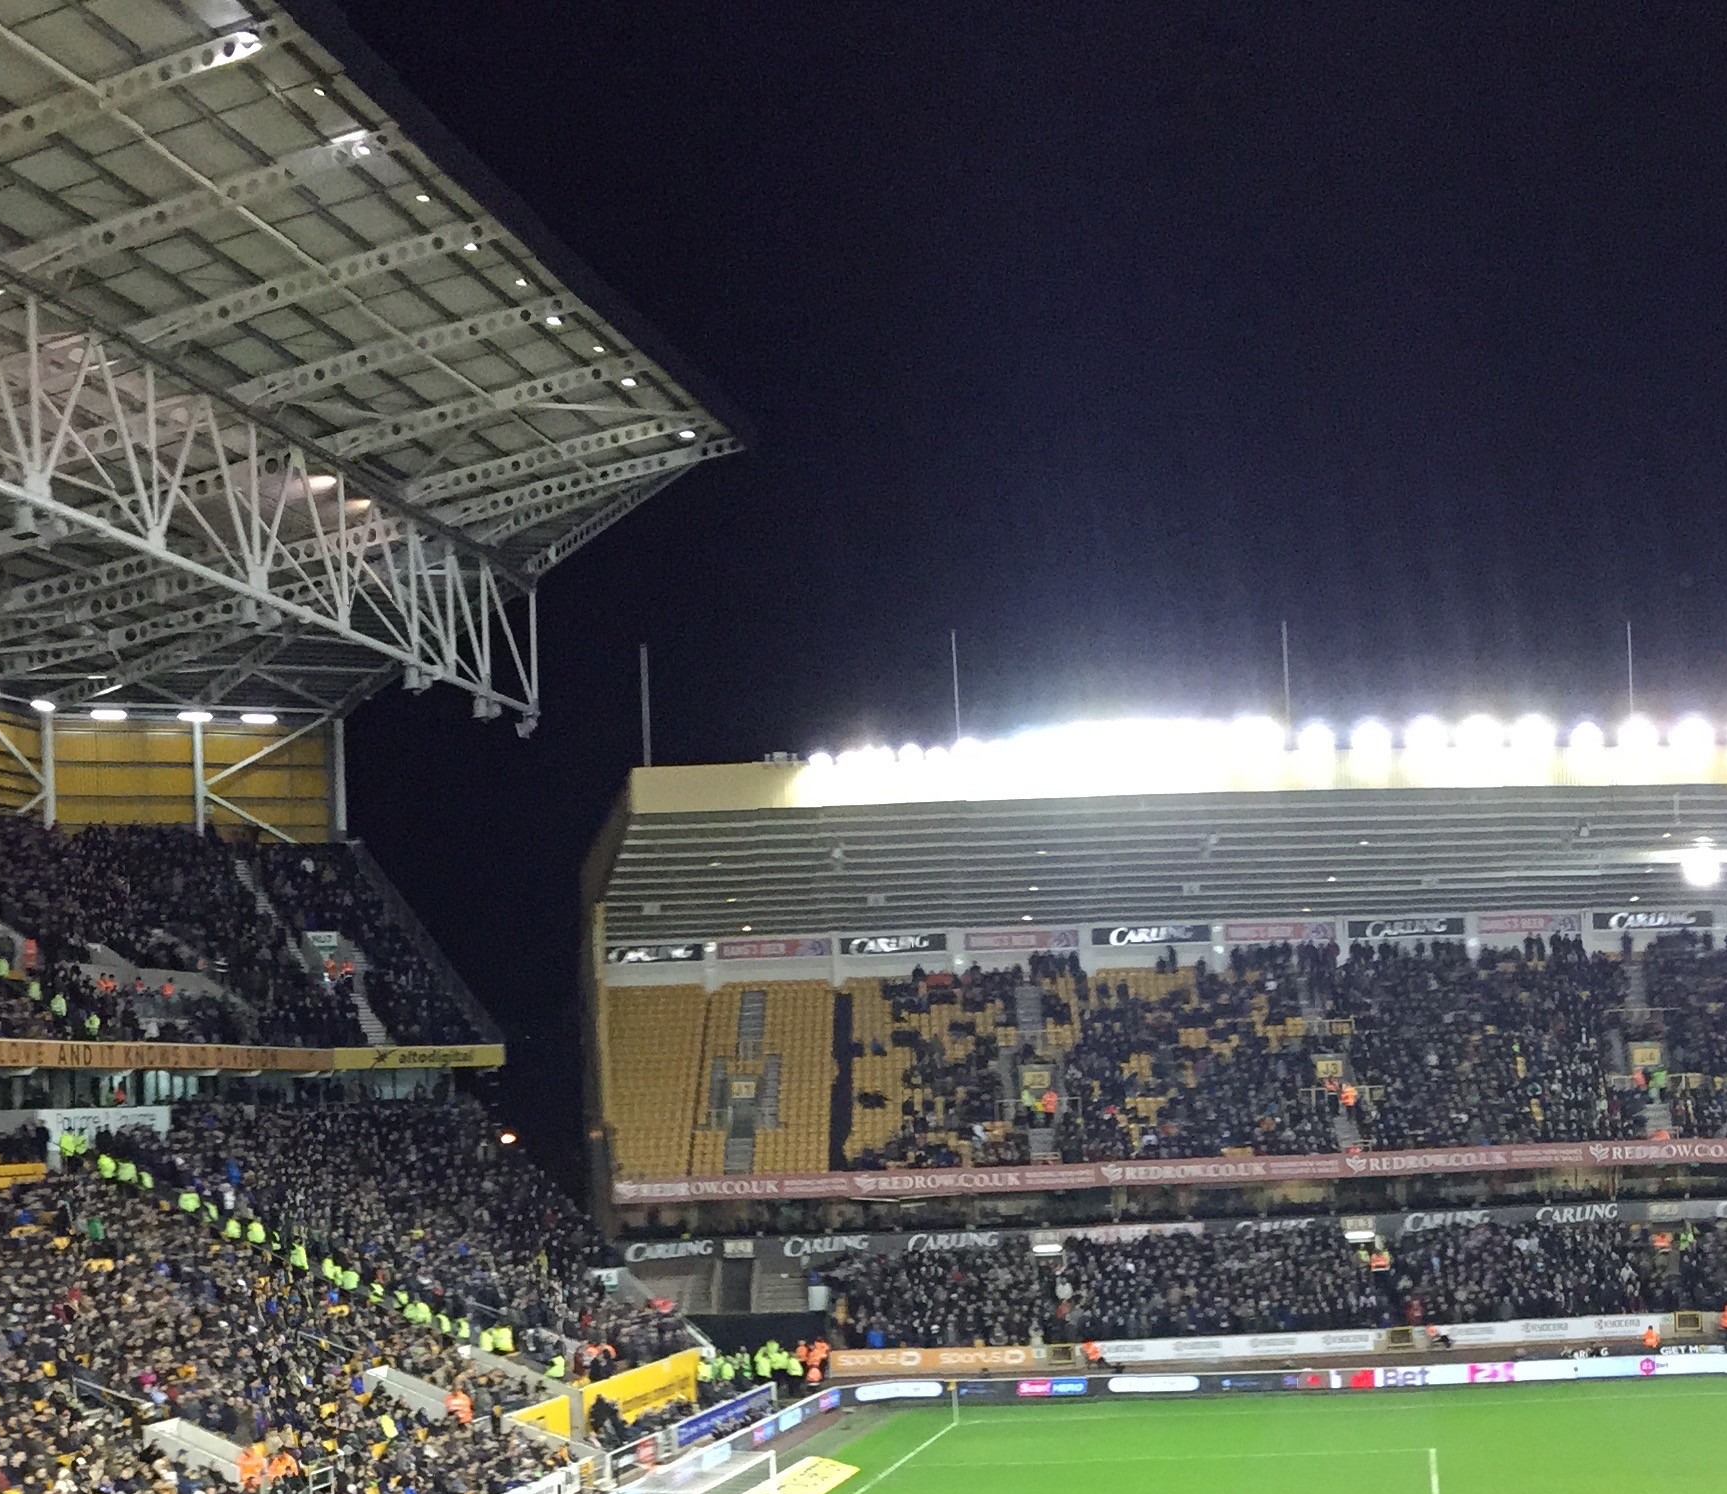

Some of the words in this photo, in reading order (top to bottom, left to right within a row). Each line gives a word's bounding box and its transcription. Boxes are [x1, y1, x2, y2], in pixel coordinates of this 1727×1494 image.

[57, 1042, 94, 1066] AND
[100, 1043, 114, 1066] IT
[1122, 1160, 1266, 1182] REDROW.CO.UK
[1366, 1150, 1508, 1174] REDROW.CO.UK
[877, 1171, 1020, 1190] REDROW.CO.UK
[1536, 1202, 1619, 1224] CARLING
[625, 1238, 714, 1263] CARLING
[783, 1233, 870, 1258] CARLING
[908, 1229, 1000, 1254] CARLING
